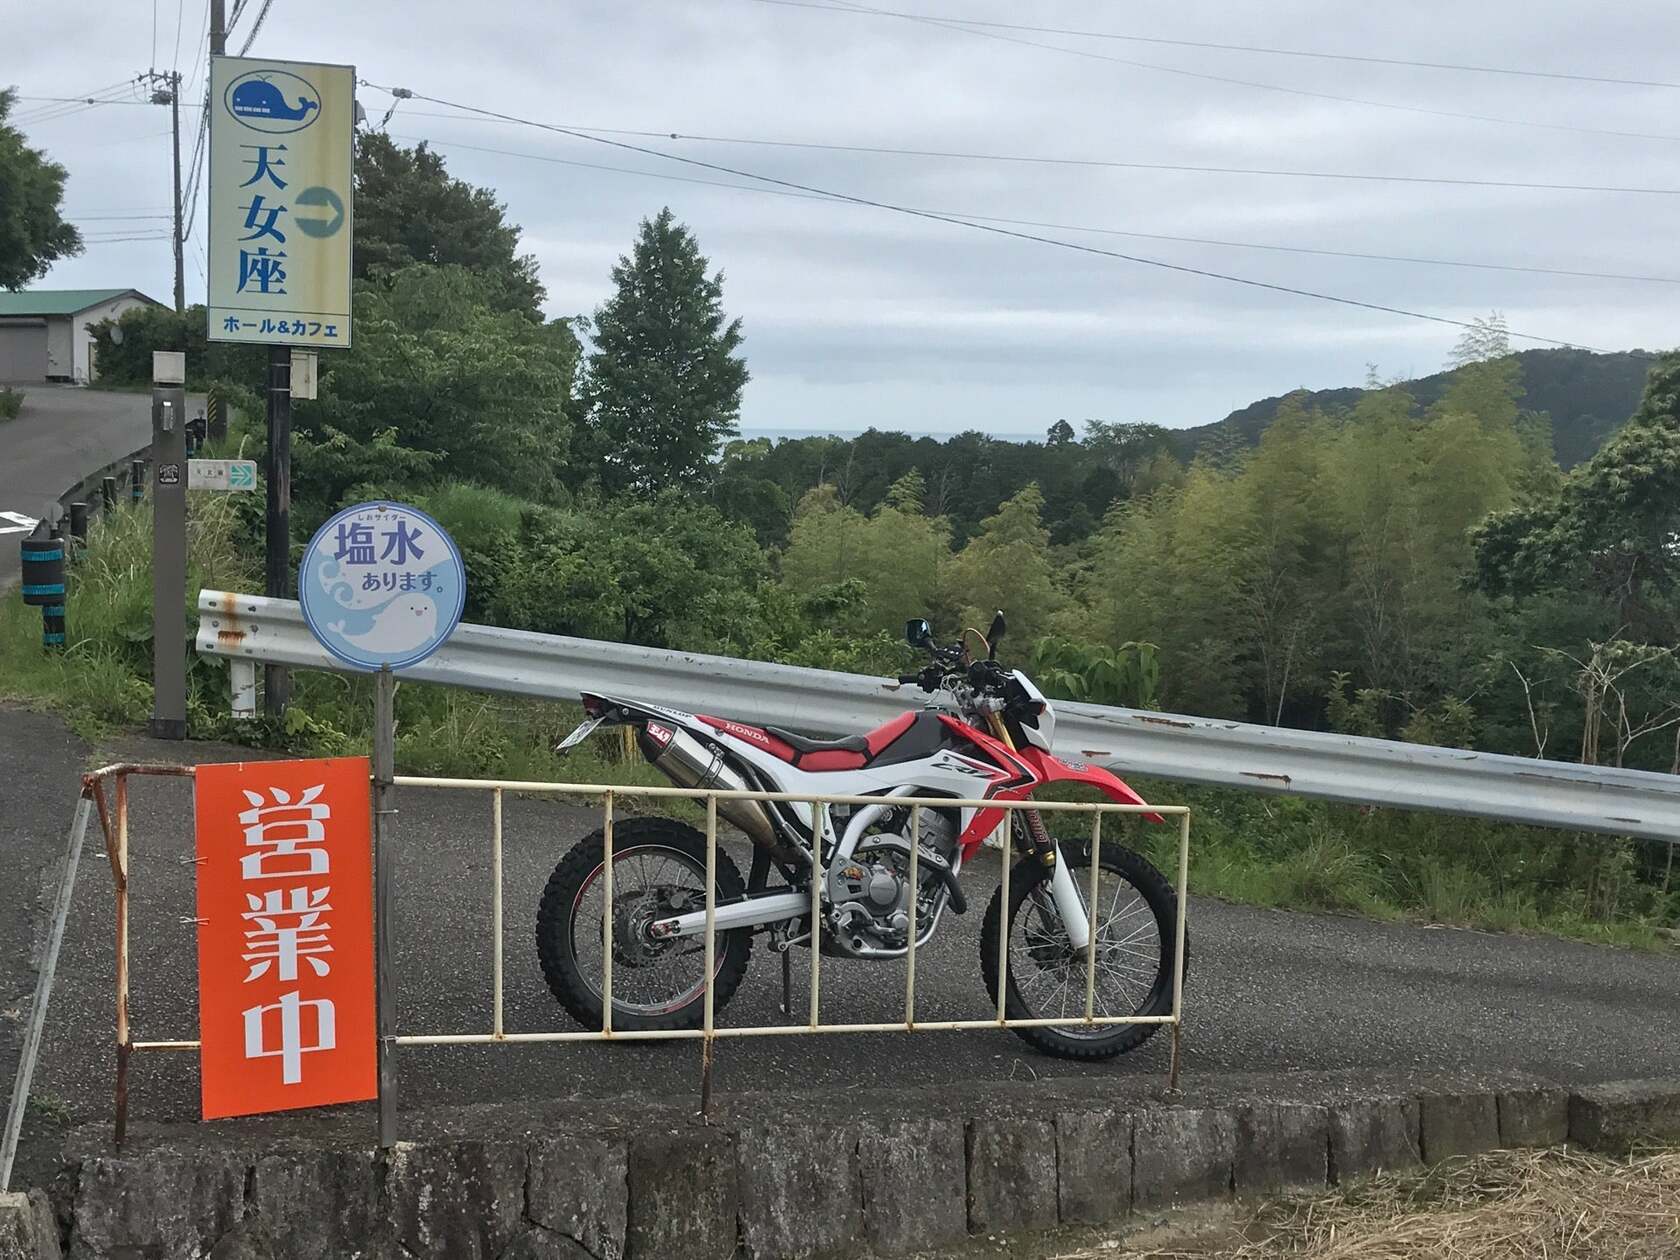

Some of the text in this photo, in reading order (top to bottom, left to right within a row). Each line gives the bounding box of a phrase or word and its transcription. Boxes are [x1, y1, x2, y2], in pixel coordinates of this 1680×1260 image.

[236, 143, 288, 295] 天女座
[223, 315, 339, 338] ホール&カフェ
[334, 520, 425, 566] 塩水
[362, 571, 444, 593] あります。
[724, 722, 770, 745] HONDA
[238, 783, 337, 1086] 営業中
